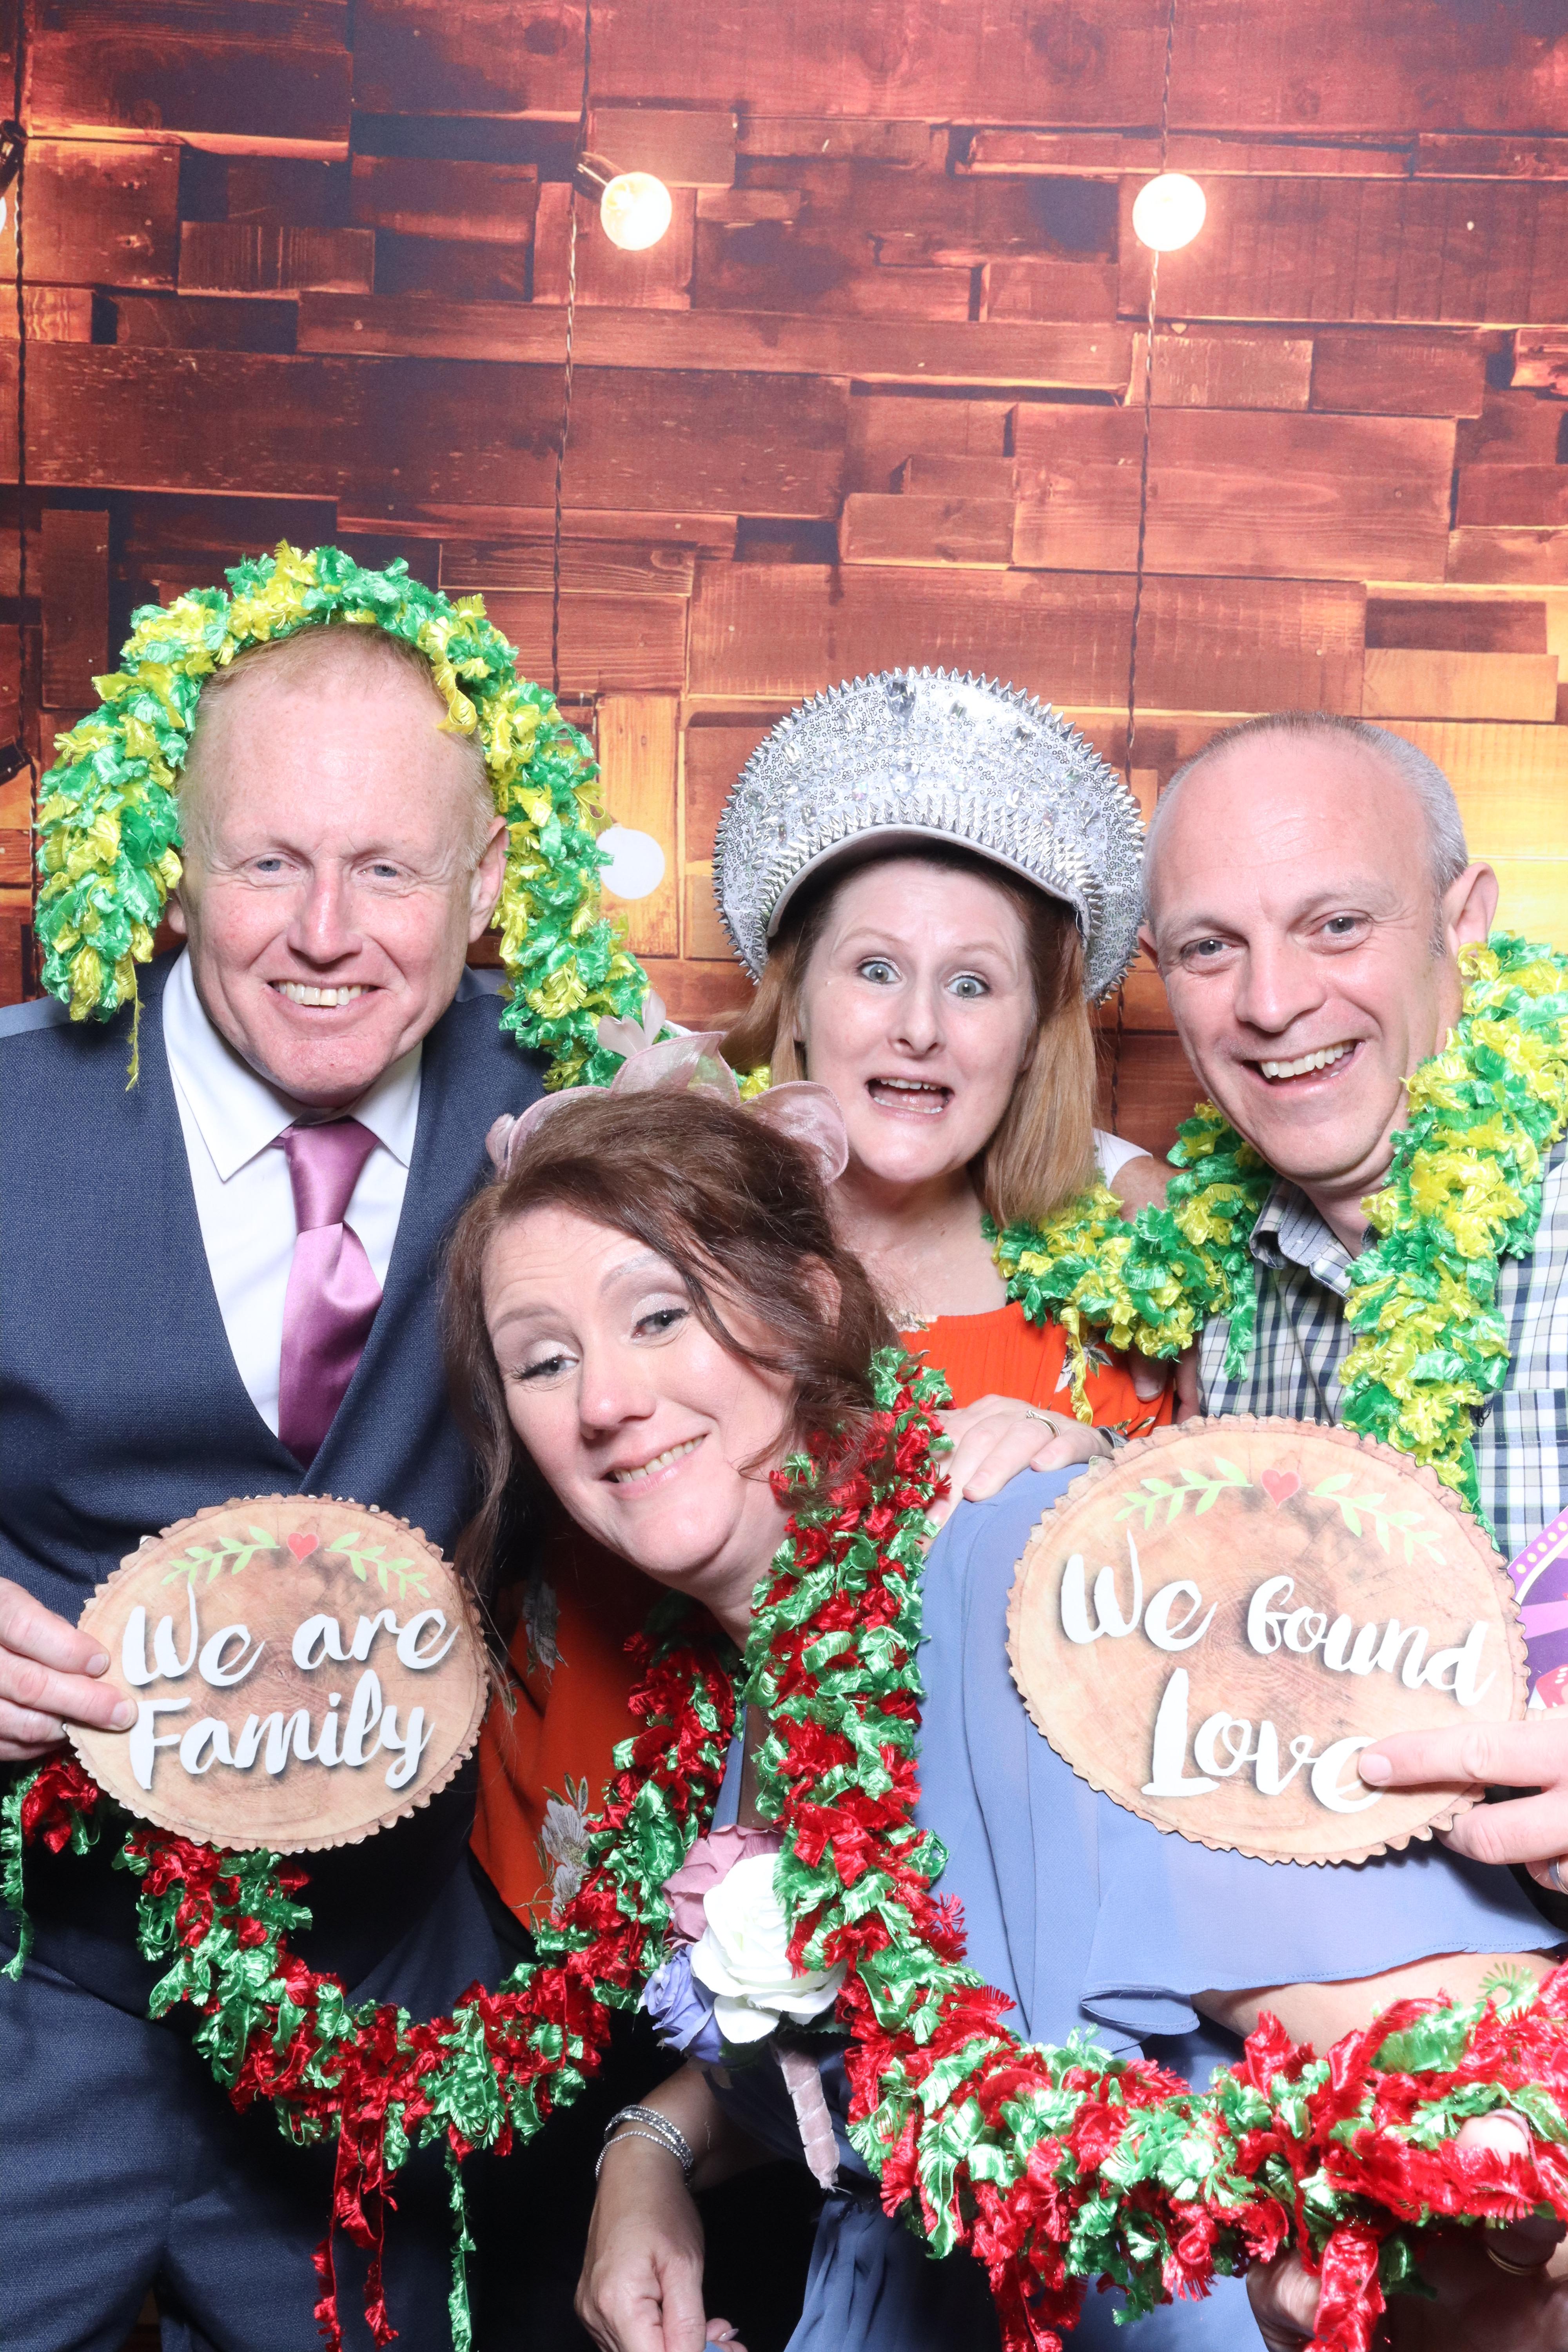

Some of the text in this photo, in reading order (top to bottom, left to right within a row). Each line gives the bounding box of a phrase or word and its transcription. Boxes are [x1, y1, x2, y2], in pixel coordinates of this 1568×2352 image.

[122, 1583, 459, 1686] We are
[1061, 1529, 1496, 1706] We found
[130, 1670, 435, 1790] Family
[1142, 1667, 1386, 1813] Love
